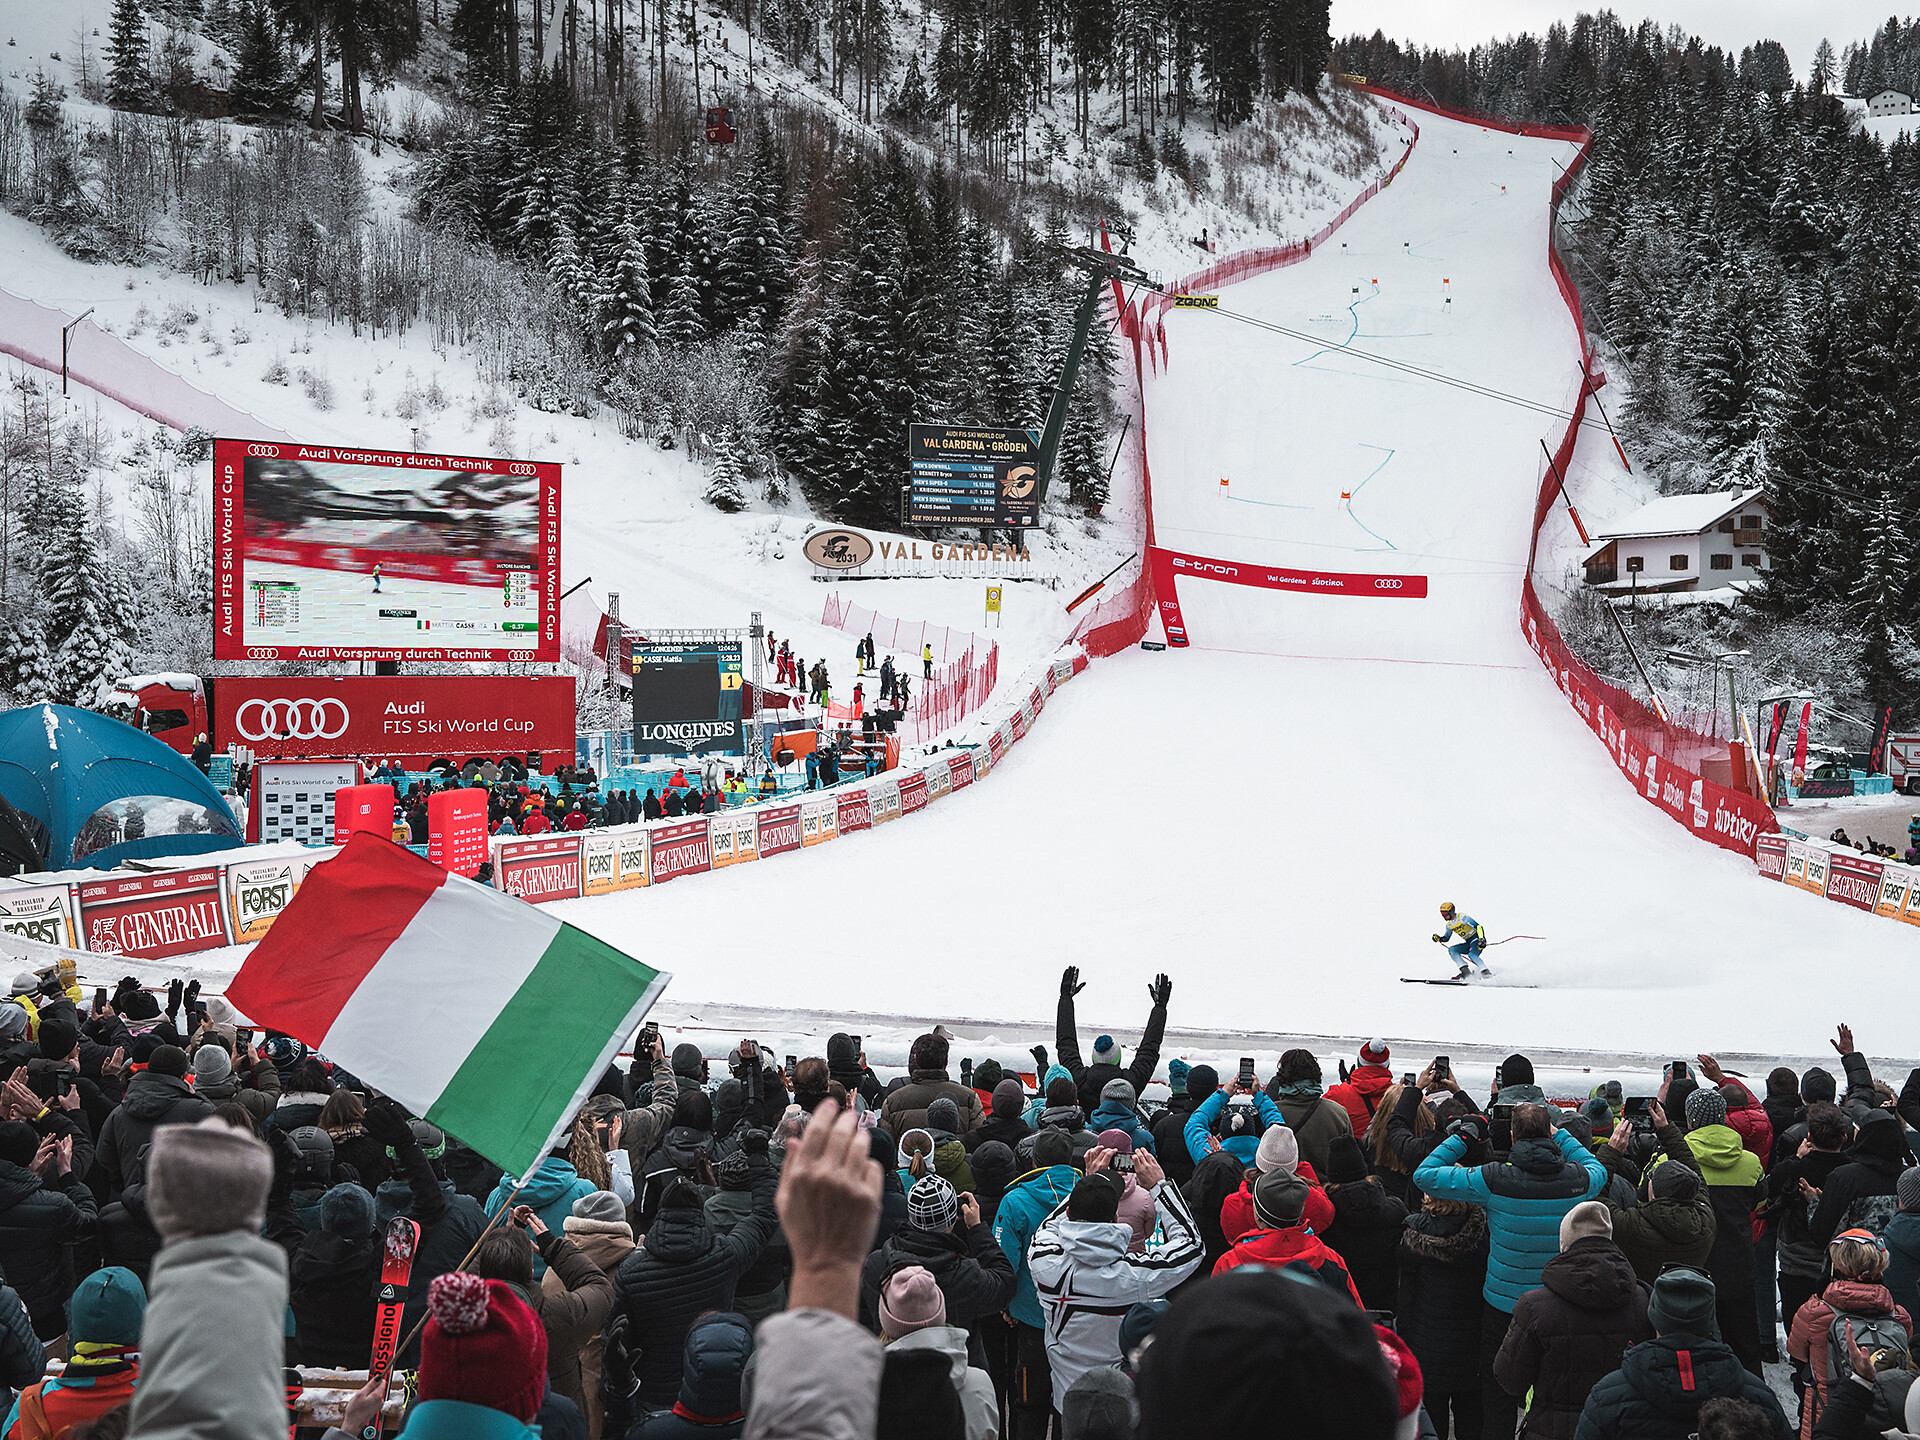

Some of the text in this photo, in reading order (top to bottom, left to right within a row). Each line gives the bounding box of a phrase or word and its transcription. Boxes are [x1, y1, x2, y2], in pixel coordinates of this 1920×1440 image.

[1175, 296, 1218, 307] ZGONC
[924, 438, 940, 448] VAL
[942, 439, 985, 450] GARDENA
[992, 440, 1027, 452] GRÖDEN
[299, 447, 493, 471] Audi Vorsprung durch Technik
[222, 464, 235, 636] Audi FIS Ski World Cup
[836, 553, 857, 563] 2031
[879, 541, 1030, 562] VAL GARDENA
[545, 485, 556, 641] Audi FIS Ski World Cup
[1172, 557, 1238, 577] e-tron
[1279, 576, 1307, 584] Gardena
[298, 647, 492, 661] Audi Vorsprung durch Technik
[727, 674, 734, 688] 1
[384, 701, 425, 715] Audi
[384, 718, 535, 736] FIS Ski World Cup
[641, 721, 735, 740] LONGINES
[714, 832, 731, 850] FORST
[737, 829, 753, 847] FORST
[769, 823, 799, 849] GENERALI
[589, 854, 612, 874] FORST
[621, 850, 643, 872] FORST
[667, 841, 709, 873] GENERALI
[523, 862, 578, 896] GENERALI
[1809, 862, 1825, 880] FORST
[242, 884, 289, 914] FORST
[1839, 875, 1877, 905] GENERALI
[1882, 882, 1905, 901] FORST
[120, 901, 223, 952] GENERALI
